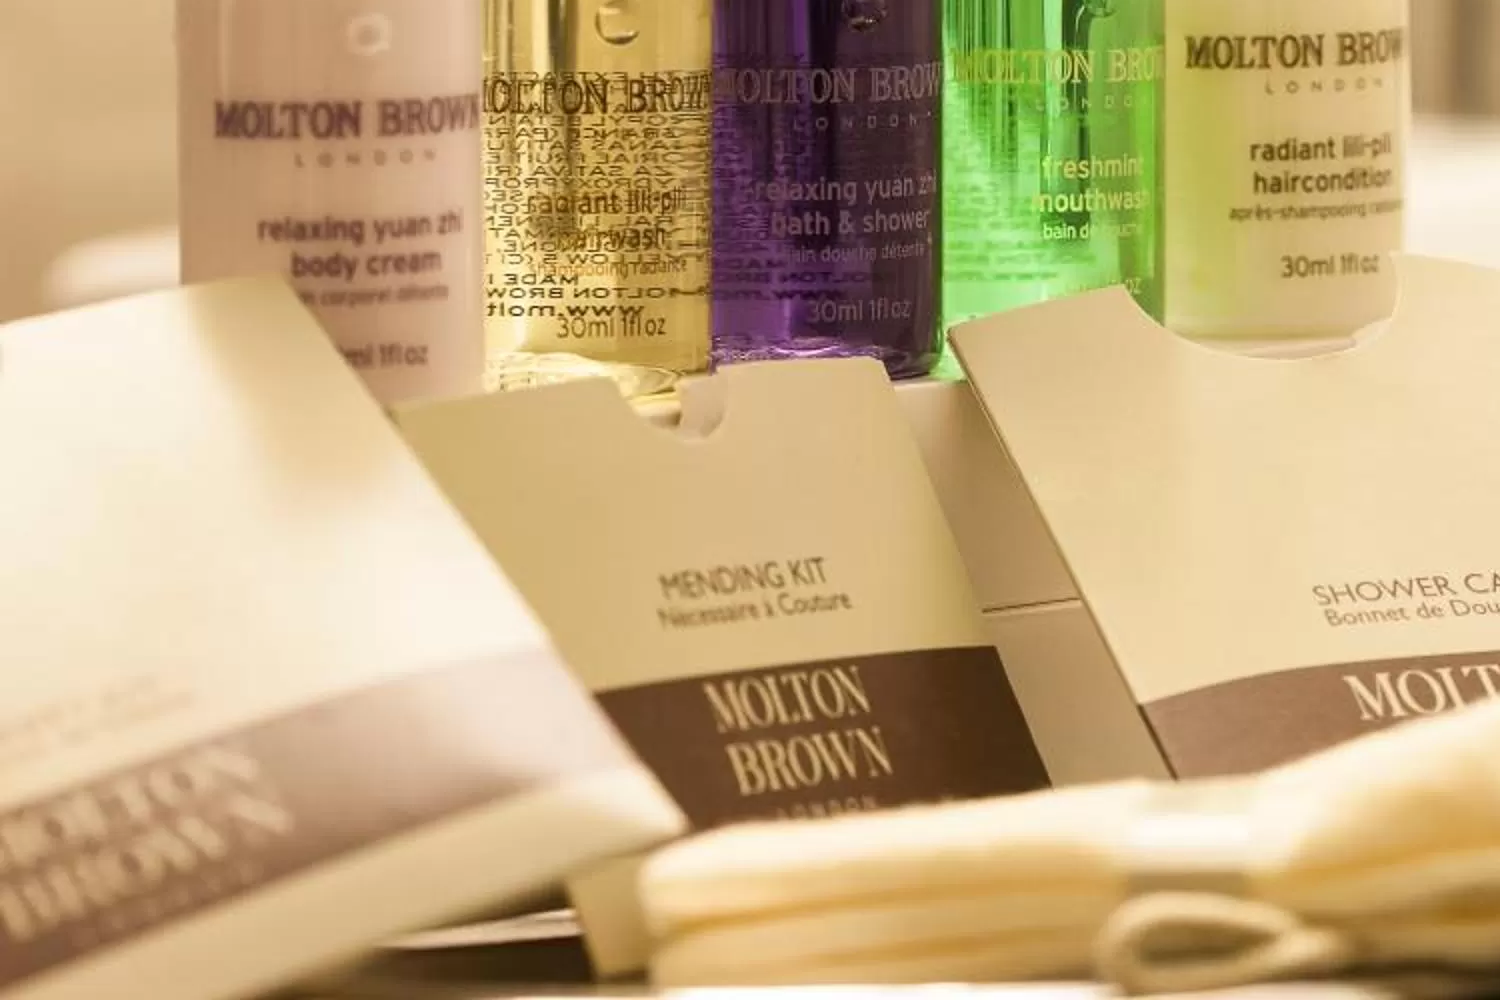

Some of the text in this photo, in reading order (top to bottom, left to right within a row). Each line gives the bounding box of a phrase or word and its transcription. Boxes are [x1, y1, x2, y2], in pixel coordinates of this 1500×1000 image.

[1185, 33, 1324, 69] MOLTON
[213, 93, 480, 139] MOLTON BROWN
[1249, 136, 1336, 162] radiant
[755, 176, 858, 206] relaxing
[864, 175, 914, 205] yuan
[257, 214, 367, 246] relaxing
[373, 214, 432, 244] yuan
[771, 208, 930, 236] bath & shower
[1043, 223, 1077, 240] bain
[291, 250, 442, 281] body cream
[1281, 255, 1335, 279] 30ml
[557, 316, 615, 339] 30ml
[658, 556, 828, 600] MENDING KIT
[1312, 575, 1452, 607] SHOWER
[776, 591, 853, 617] Couture
[1325, 602, 1410, 627] Bonnet
[1416, 598, 1444, 621] de
[703, 664, 871, 734] MOLTON
[725, 726, 894, 797] BROWN
